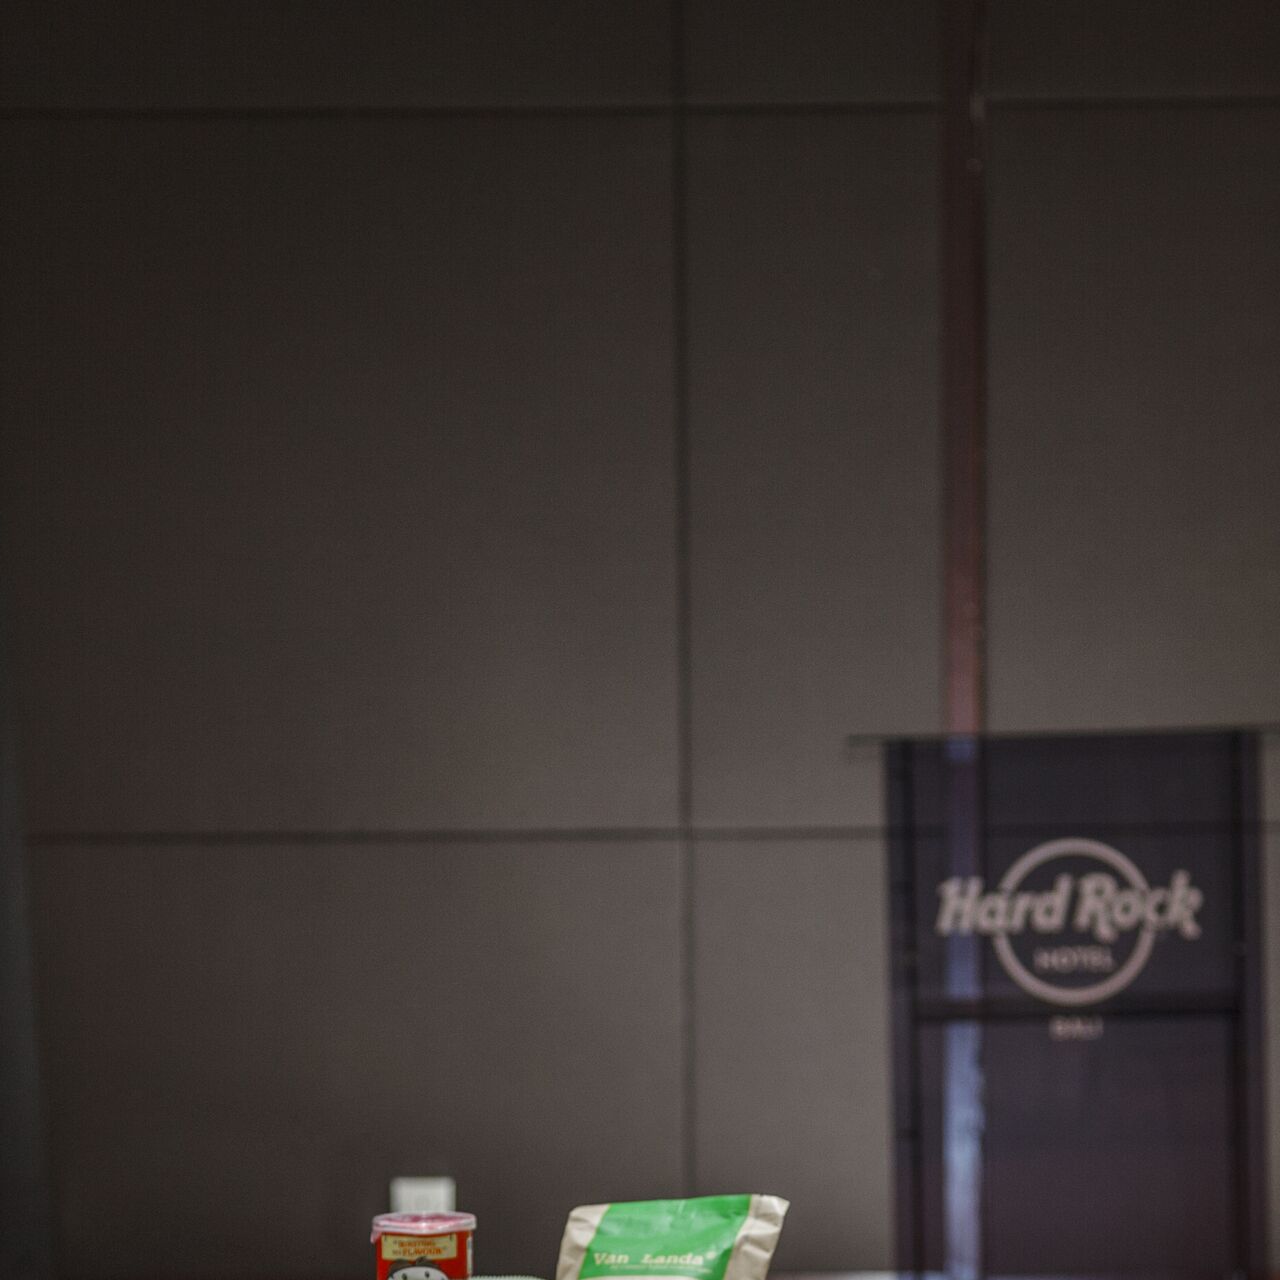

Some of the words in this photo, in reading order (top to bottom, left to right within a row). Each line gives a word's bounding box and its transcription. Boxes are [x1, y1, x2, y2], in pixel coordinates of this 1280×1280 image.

[936, 872, 1074, 936] Hard
[1075, 869, 1204, 942] Rock
[1033, 947, 1114, 972] HOTEL
